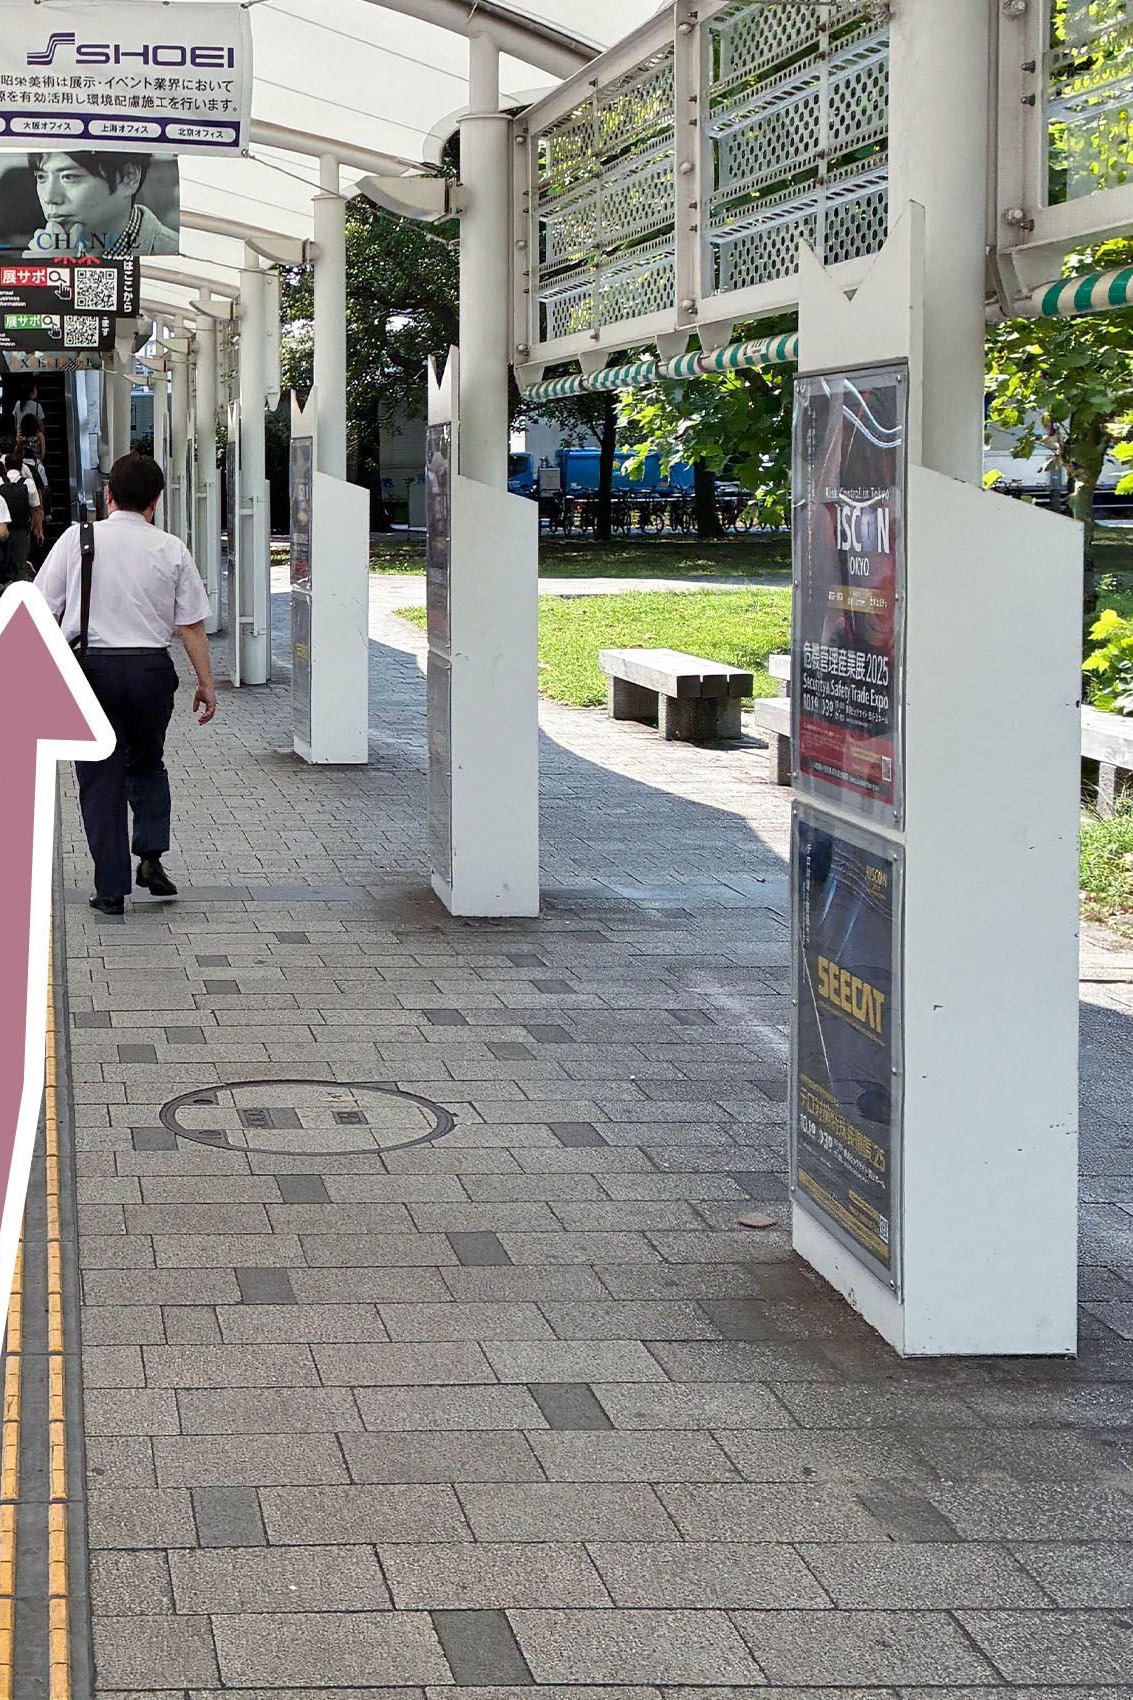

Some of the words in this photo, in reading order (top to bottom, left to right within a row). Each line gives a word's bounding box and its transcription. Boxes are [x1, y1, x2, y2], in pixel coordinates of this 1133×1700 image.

[75, 44, 235, 69] SHOEI
[0, 74, 235, 94] 昭栄美術は展示・イベント業界において
[23, 121, 72, 132] 大阪オフィス
[101, 123, 149, 135] 上海オフィス
[178, 127, 224, 139] 北京オフィス
[2, 269, 47, 285] 展サポ
[6, 314, 42, 328] 展サポ
[870, 688, 889, 713] Expo
[818, 955, 885, 1034] SEECAT
